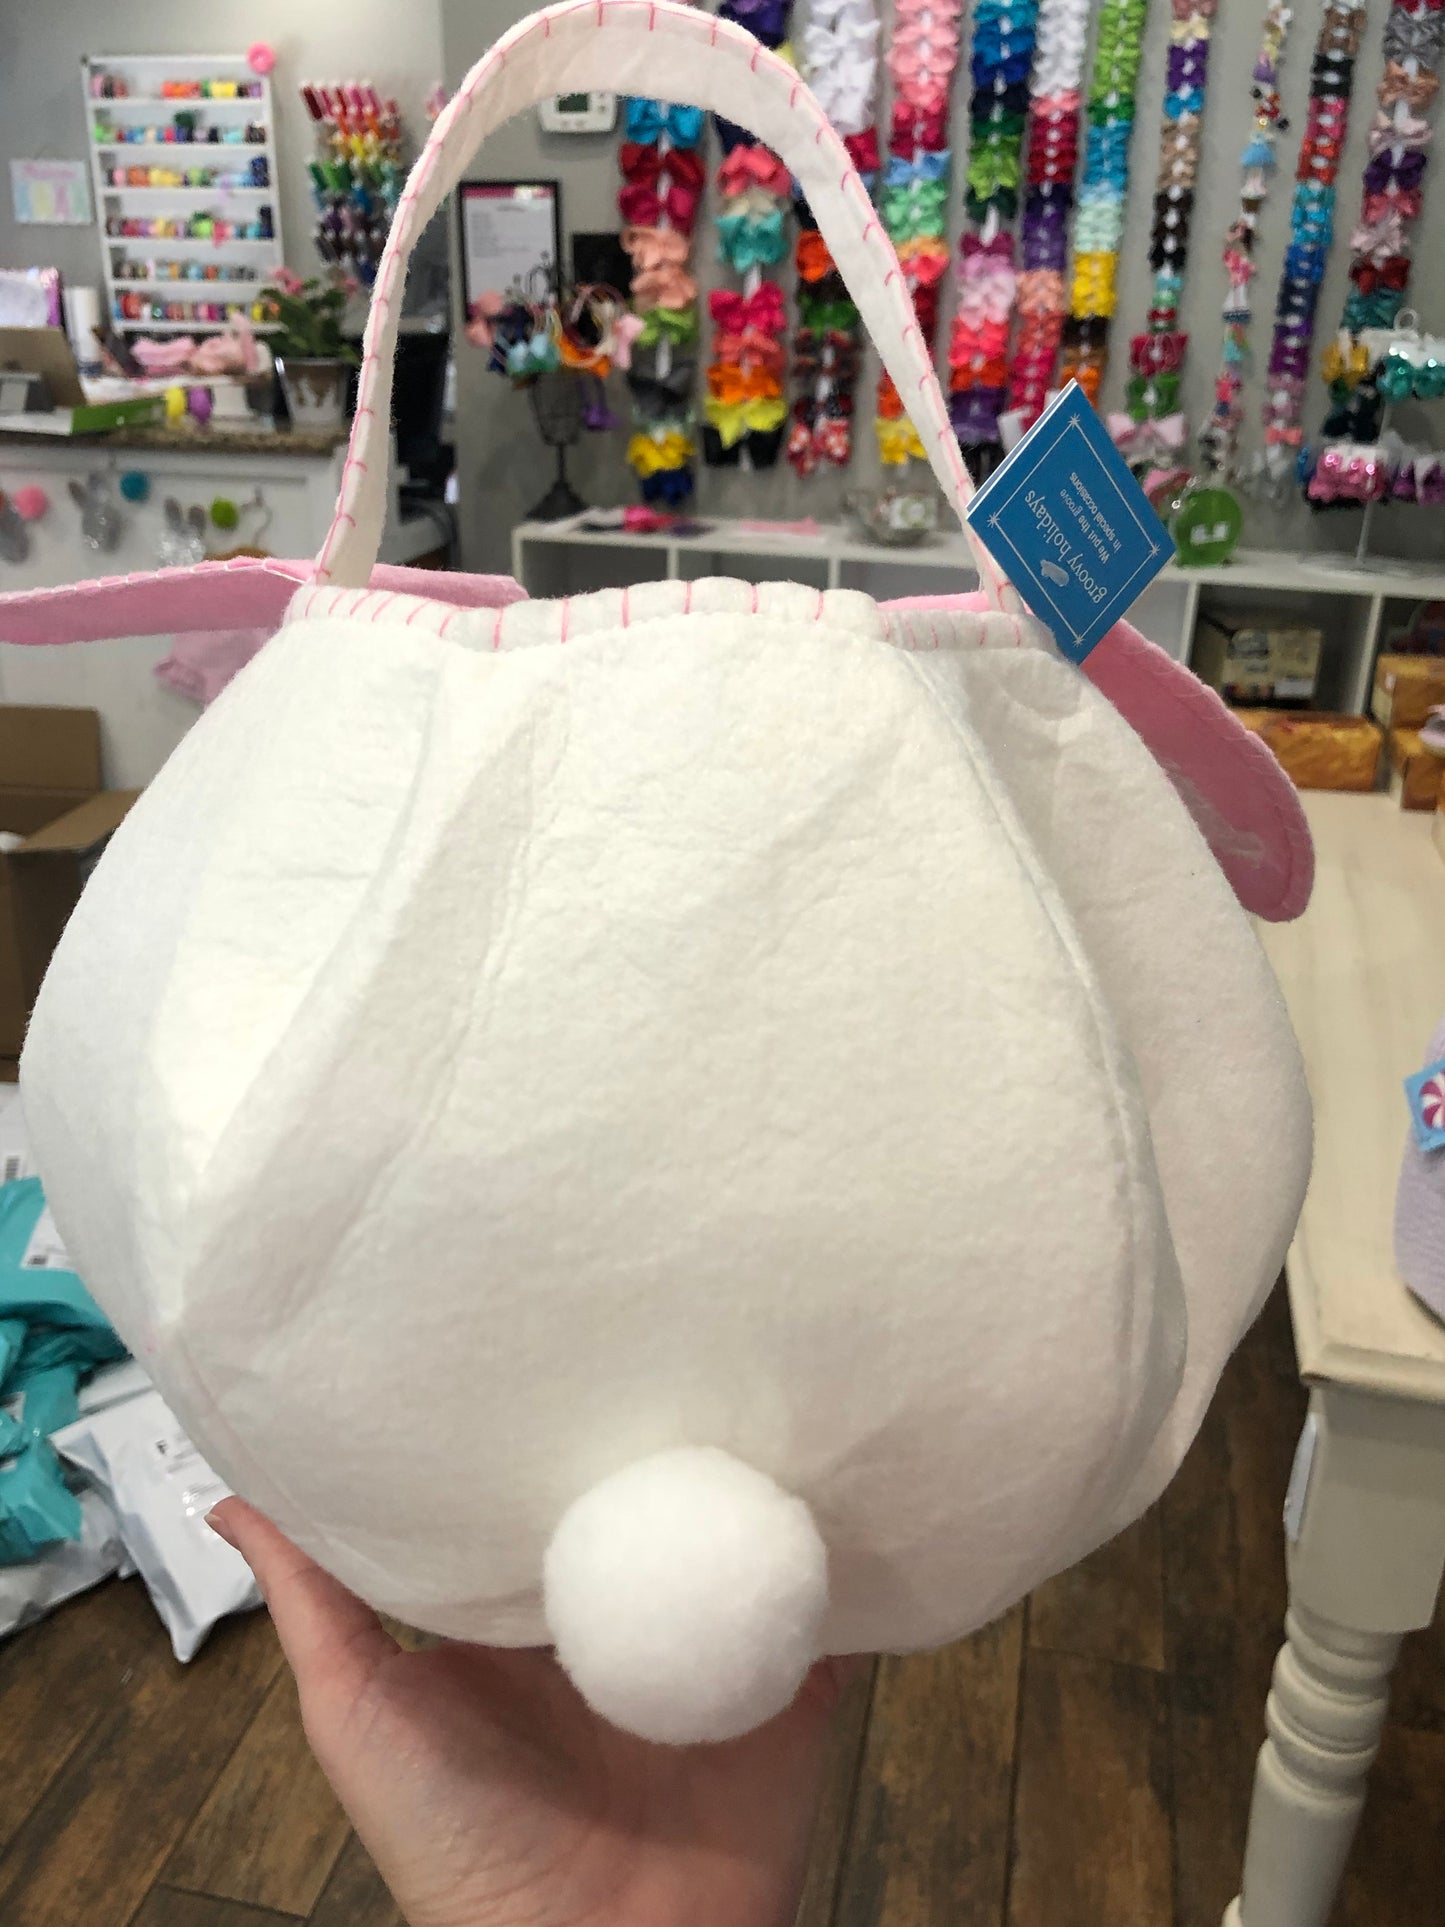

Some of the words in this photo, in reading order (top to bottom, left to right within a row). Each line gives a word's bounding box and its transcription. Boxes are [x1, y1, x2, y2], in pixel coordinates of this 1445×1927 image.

[1060, 489, 1083, 517] groove
[1070, 472, 1097, 514] occasions
[1025, 490, 1072, 562] holidays
[1078, 515, 1091, 534] the
[1087, 530, 1103, 548] put
[1094, 511, 1116, 541] special
[1099, 547, 1110, 564] We
[1067, 553, 1108, 604] groovy
